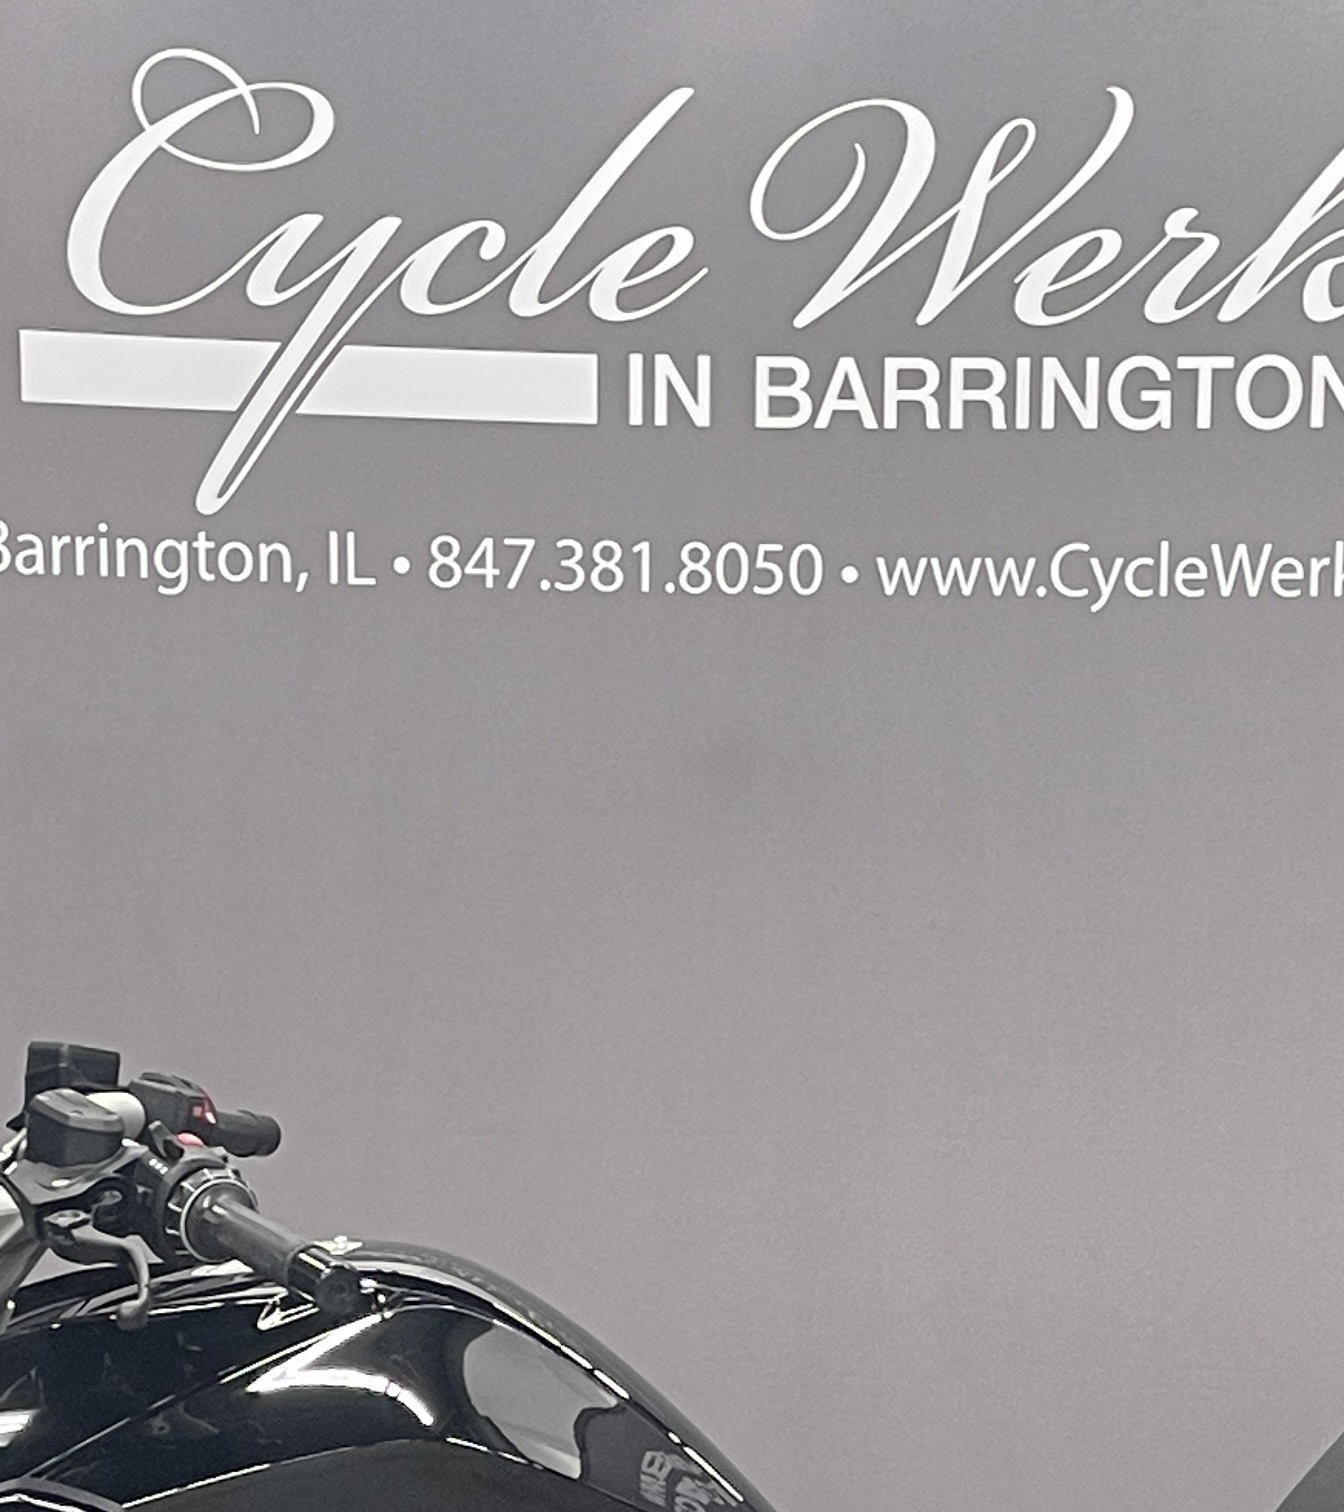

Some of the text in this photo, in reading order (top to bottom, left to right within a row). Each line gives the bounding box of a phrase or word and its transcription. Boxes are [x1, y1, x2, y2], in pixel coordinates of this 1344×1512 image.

[67, 47, 711, 515] Cycle
[628, 352, 712, 428] IN
[328, 530, 378, 587] IL
[428, 534, 824, 597] 847.381.8050
